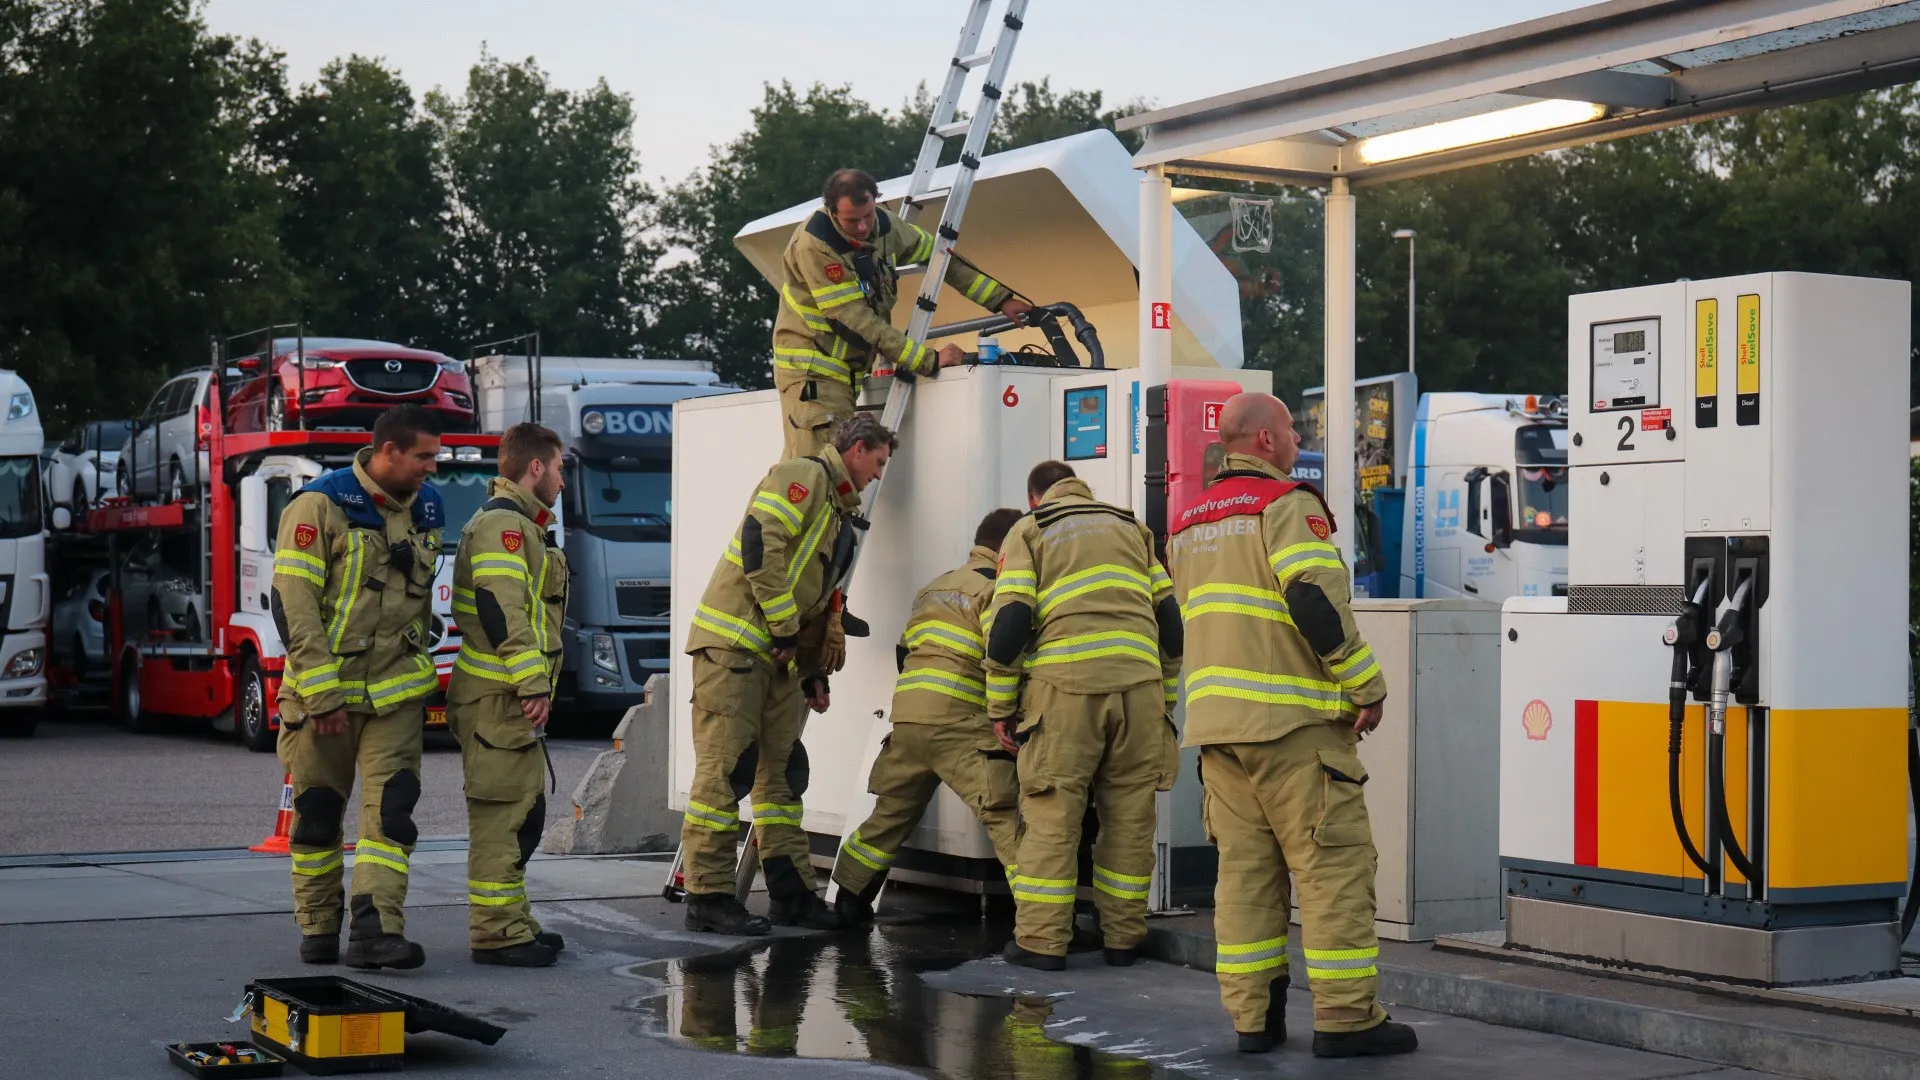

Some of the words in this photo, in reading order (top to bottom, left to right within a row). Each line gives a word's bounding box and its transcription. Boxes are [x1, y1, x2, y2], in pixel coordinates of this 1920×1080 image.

[1705, 312, 1714, 368] FuelSave
[1747, 308, 1756, 365] FuelSave
[1002, 384, 1019, 408] 6
[1617, 415, 1635, 451] 2
[1416, 486, 1425, 575] HOLCON.COM
